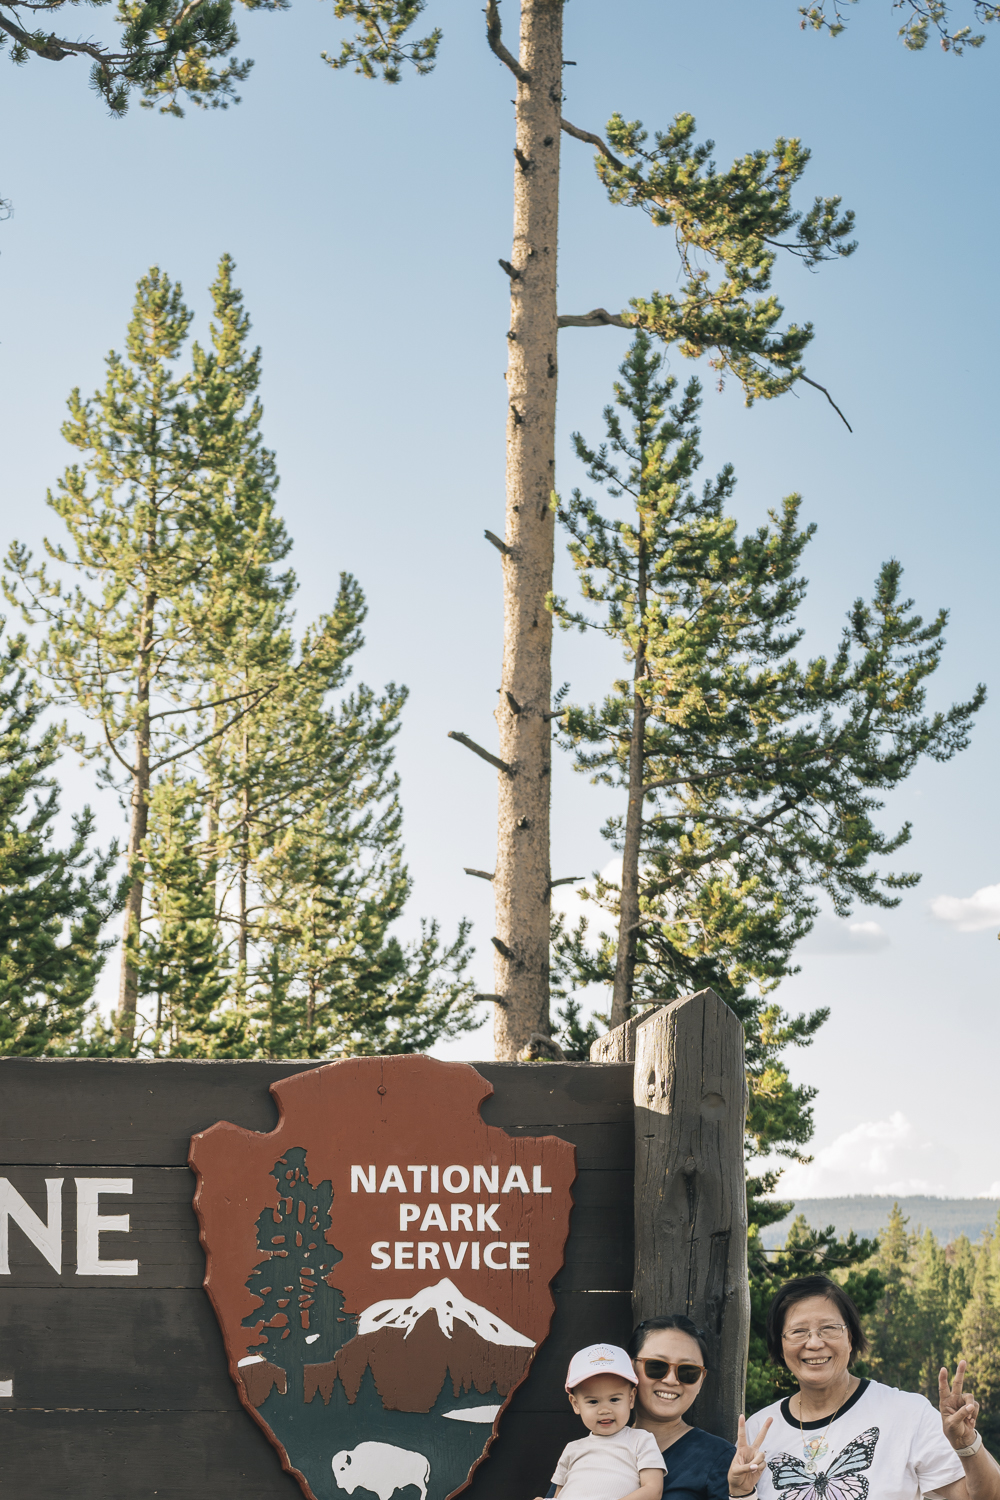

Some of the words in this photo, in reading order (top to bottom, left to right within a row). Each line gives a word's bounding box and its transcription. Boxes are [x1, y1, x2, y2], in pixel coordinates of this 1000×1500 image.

[350, 1164, 552, 1194] NATIONAL
[398, 1203, 502, 1232] PARK
[370, 1241, 530, 1271] SERVICE
